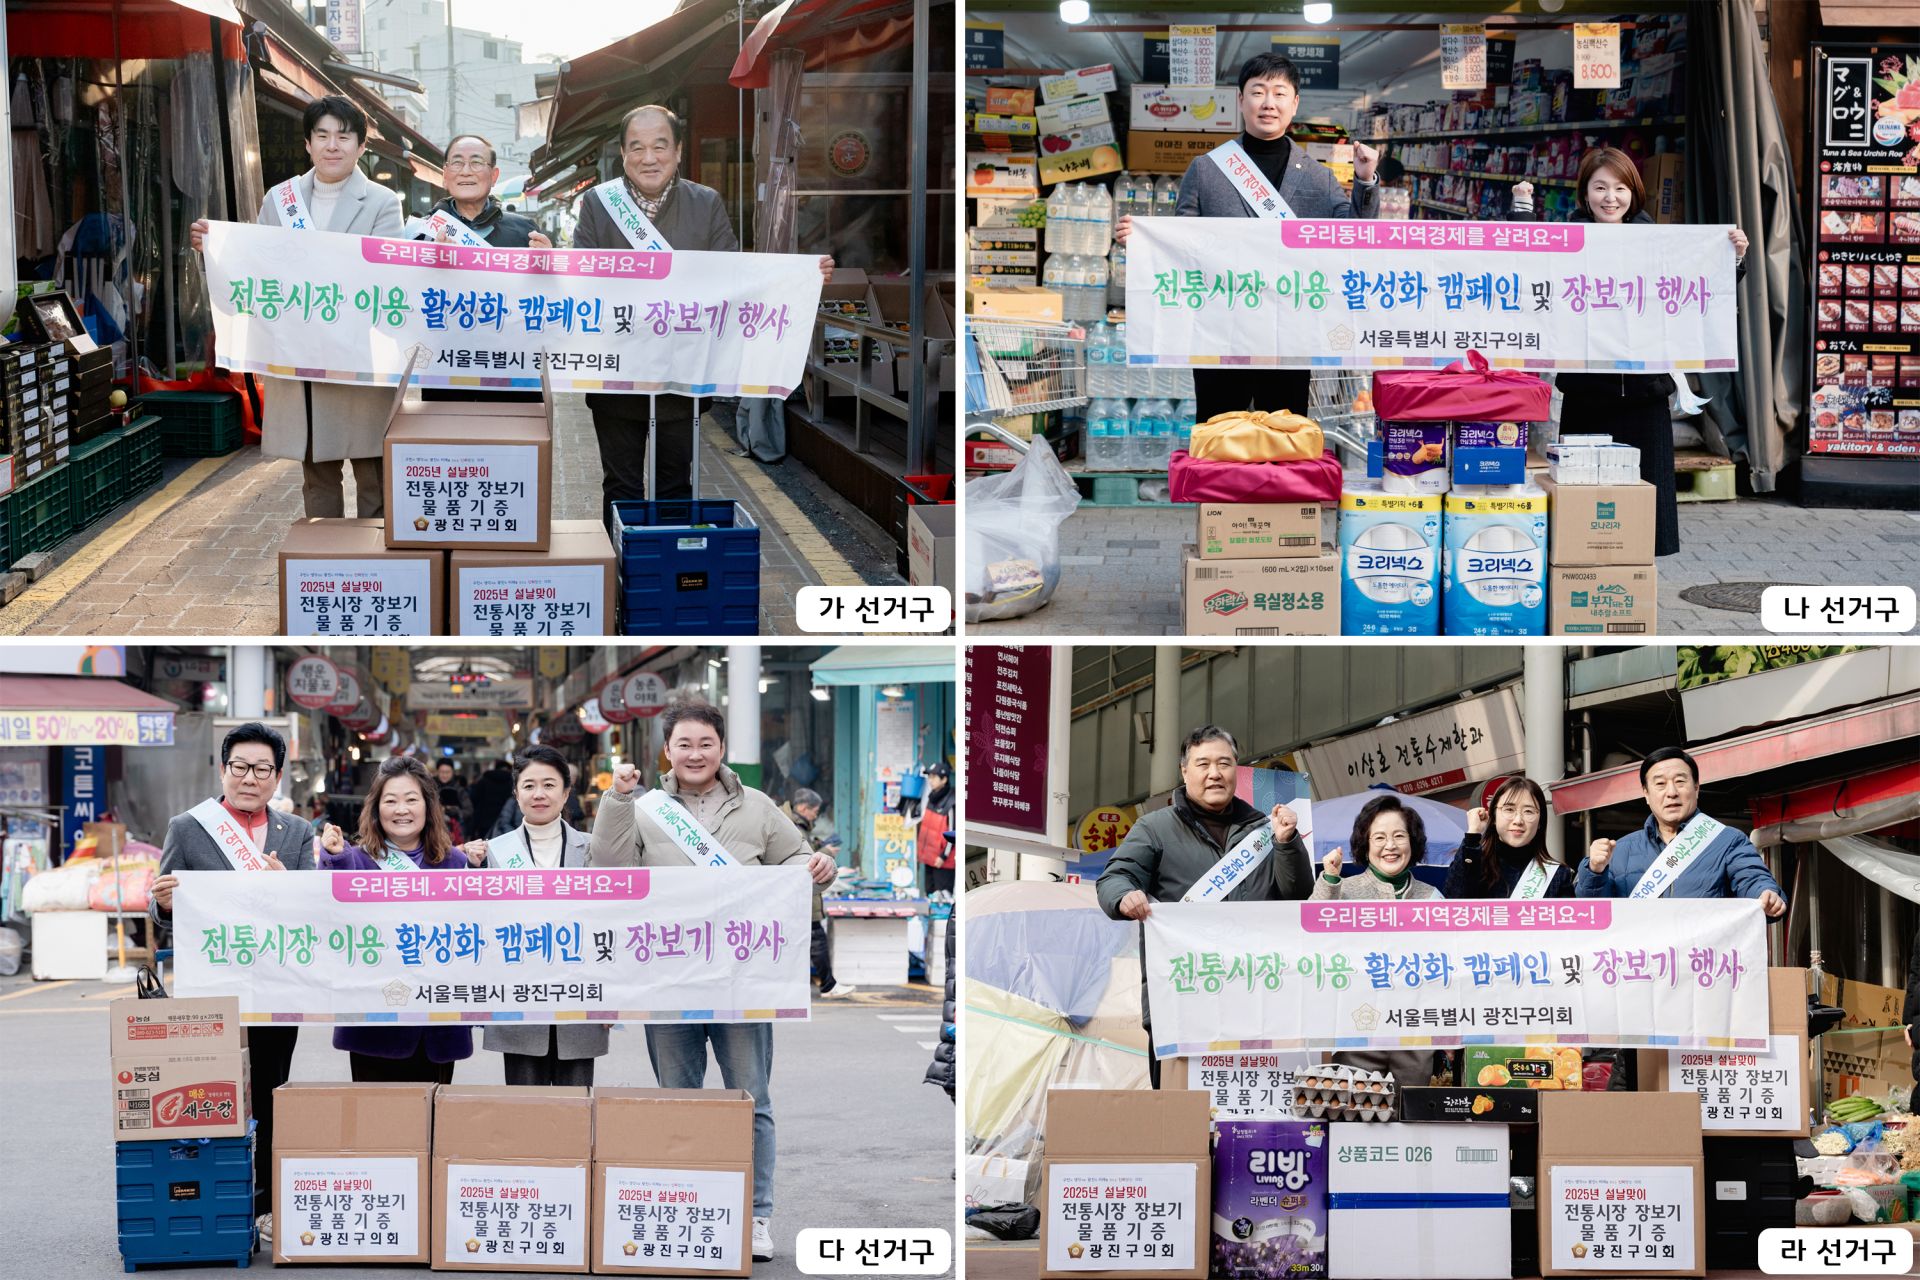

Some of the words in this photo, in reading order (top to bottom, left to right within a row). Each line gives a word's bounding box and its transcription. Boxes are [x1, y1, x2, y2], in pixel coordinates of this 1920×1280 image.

[1822, 149, 1839, 157] Tuna
[1058, 158, 1091, 173] 나주배
[1225, 153, 1277, 211] 지역경제를
[1297, 224, 1381, 244] 우리동네.
[1388, 225, 1486, 246] 지역경제를
[1491, 226, 1568, 247] 살려요~!
[379, 243, 463, 267] 우리동네.
[473, 250, 569, 273] 지역경제를
[577, 254, 655, 275] 살려요~!
[1151, 268, 1267, 311] 전통시장
[1275, 272, 1332, 310] 이용
[1341, 269, 1428, 312] 활성화
[1437, 271, 1522, 313] 캠페인
[1532, 279, 1552, 312] 및
[1561, 274, 1646, 315] 장보기
[1656, 276, 1713, 317] 행사
[229, 277, 344, 327] 전통시장
[354, 283, 411, 327] 이용
[421, 288, 508, 331] 활성화
[518, 295, 602, 333] 캠페인
[613, 304, 634, 332] 및
[643, 299, 730, 338] 장보기
[738, 303, 792, 340] 행사
[1359, 329, 1447, 350] 서울특별시
[1453, 330, 1541, 350] 광진구의회
[1829, 341, 1857, 351] おでん
[436, 347, 525, 370] 서울특별시
[532, 351, 621, 373] 광진구의회
[1388, 428, 1423, 438] 크리넥스
[1459, 429, 1495, 439] 크리넥스
[1826, 442, 1873, 453] yakitory
[1876, 444, 1884, 452] &
[1887, 444, 1916, 453] oden
[406, 466, 441, 478] 2025년
[448, 465, 489, 479] 설날맞이
[405, 480, 470, 498] 전통시장
[477, 481, 524, 499] 장보기
[1381, 500, 1406, 509] 특별기획
[1490, 502, 1515, 510] 특별기획
[1590, 521, 1622, 530] 모나리자
[1357, 555, 1424, 571] 크리넥스
[1467, 558, 1534, 574] 크리넥스
[300, 581, 335, 593] 2025년
[341, 580, 383, 594] 설날맞이
[473, 587, 509, 600] 2025년
[299, 596, 364, 613] 전통시장
[372, 596, 417, 613] 장보기
[1204, 592, 1248, 614] 유한락스
[1253, 591, 1325, 611] 욕실청소용
[996, 665, 1018, 680] 전주김치
[635, 677, 657, 692] 농촌
[996, 680, 1023, 695] 포천세탁소
[995, 708, 1022, 724] 풍년방앗간
[994, 738, 1016, 751] 보물찾기
[1347, 743, 1391, 778] 이상호
[1395, 722, 1484, 768] 전통수제한과
[993, 767, 1020, 781] 나들이식당
[655, 802, 710, 855] 전통시장을
[1665, 818, 1718, 869] 전통시장을
[1203, 848, 1254, 897] 이용해요!
[348, 876, 435, 898] 우리동네.
[444, 874, 545, 897] 지역경제를
[552, 873, 633, 896] 살려요~!
[1317, 907, 1404, 928] 우리동네.
[1411, 906, 1511, 928] 지역경제를
[1519, 905, 1595, 927] 살려요~!
[201, 923, 319, 966] 전통시장
[328, 924, 385, 966] 이용
[395, 922, 486, 965] 활성화
[495, 921, 583, 963] 캠페인
[593, 930, 615, 963] 및
[625, 919, 714, 963] 장보기
[724, 919, 786, 963] 행사
[1168, 951, 1287, 993] 전통시장
[1297, 952, 1354, 991] 이용
[1365, 951, 1453, 989] 활성화
[1463, 950, 1552, 988] 캠페인
[1561, 955, 1582, 986] 및
[1592, 946, 1679, 989] 장보기
[1688, 946, 1745, 989] 행사
[415, 982, 505, 1003] 서울특별시
[512, 982, 603, 1003] 광진구의회
[1385, 1008, 1476, 1028] 서울특별시
[1482, 1006, 1574, 1026] 광진구의회
[134, 1071, 160, 1083] 농심
[188, 1088, 206, 1099] 매운
[1443, 1095, 1472, 1107] 한라봉
[181, 1100, 233, 1120] 새우깡
[1337, 1145, 1400, 1163] 상품코드
[1405, 1146, 1432, 1162] 026
[1249, 1150, 1312, 1191] 리빙
[294, 1179, 328, 1192] 2025년
[333, 1178, 372, 1192] 설날맞이
[1062, 1186, 1099, 1199] 2025년
[1105, 1186, 1147, 1199] 설날맞이
[618, 1189, 652, 1201] 2025년
[658, 1189, 698, 1203] 설날맞이
[1250, 1196, 1278, 1207] 라벤더
[1565, 1188, 1600, 1200] 2025년
[1605, 1187, 1647, 1201] 설날맞이
[293, 1194, 353, 1212] 전통시장
[361, 1194, 406, 1212] 장보기
[617, 1203, 676, 1223] 전통시장
[686, 1205, 731, 1224] 장보기
[1061, 1202, 1125, 1221] 전통시장
[1134, 1202, 1182, 1221] 장보기
[1564, 1204, 1627, 1222] 전통시장
[1635, 1203, 1681, 1222] 장보기
[1291, 1263, 1310, 1272] 33m
